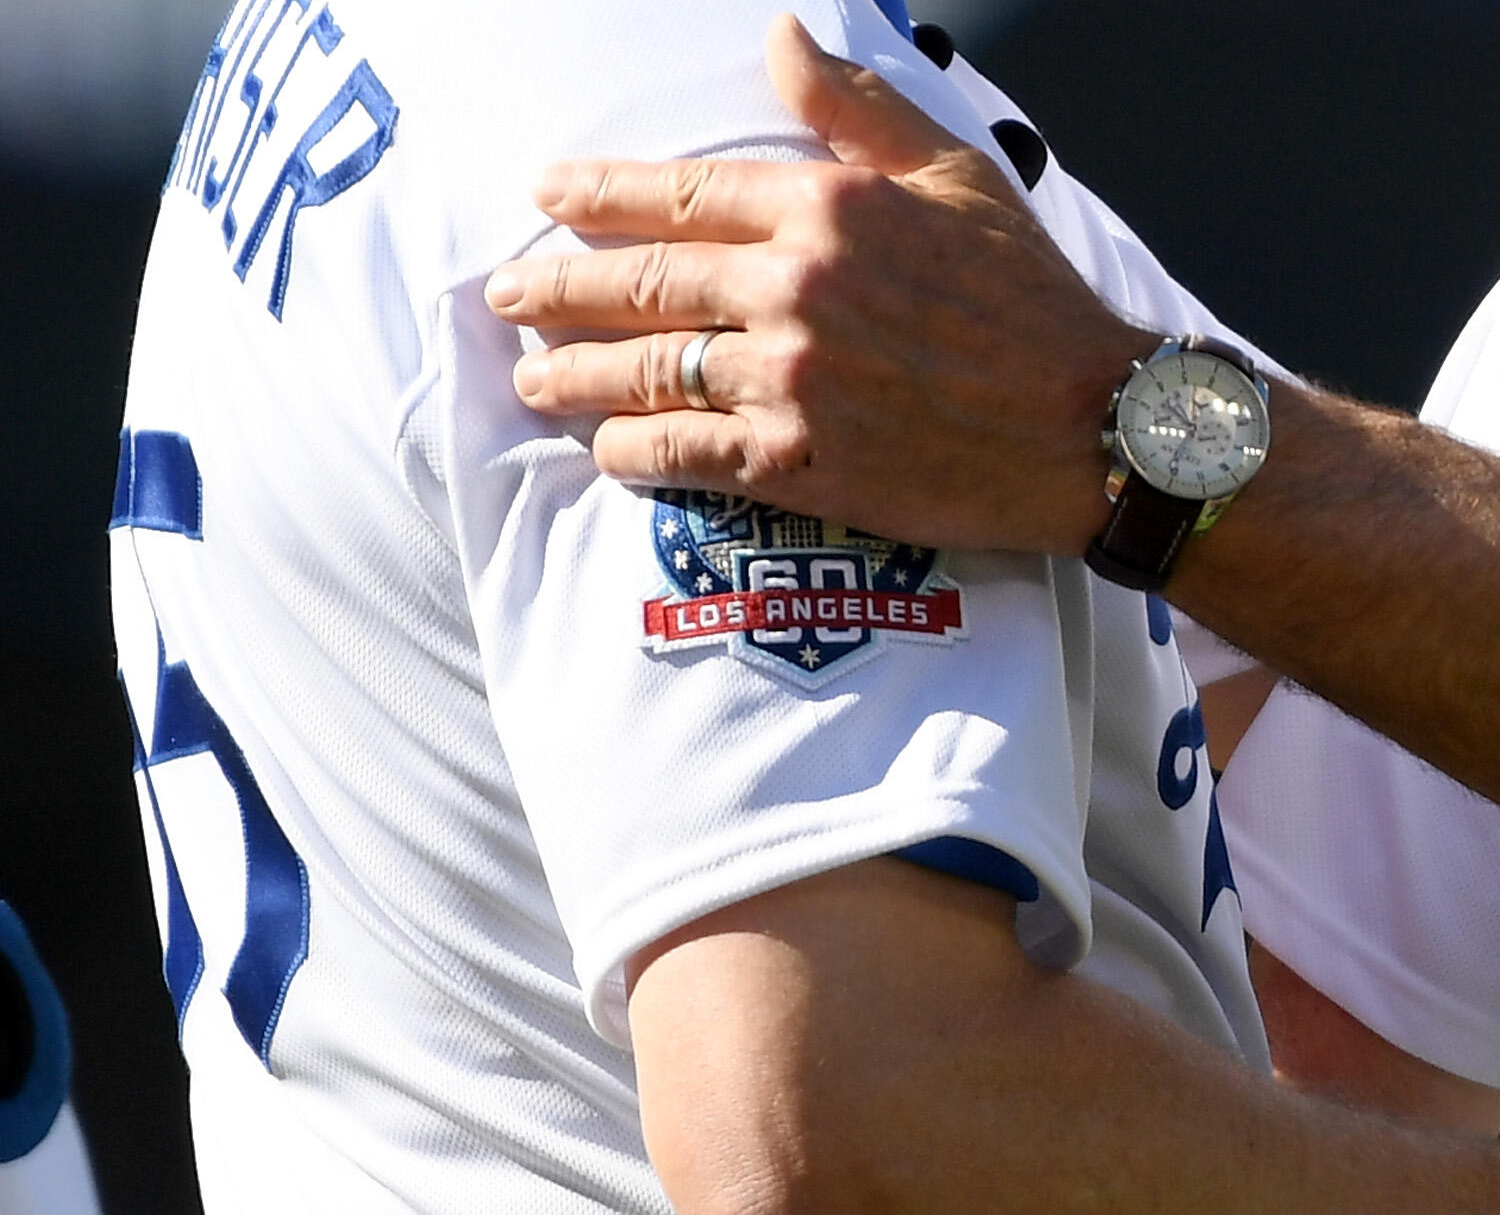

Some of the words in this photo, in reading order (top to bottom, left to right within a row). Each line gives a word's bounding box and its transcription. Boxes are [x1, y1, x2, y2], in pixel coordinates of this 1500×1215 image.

[676, 601, 745, 632] LOS
[766, 596, 929, 626] ANGELES
[748, 558, 862, 644] 60
